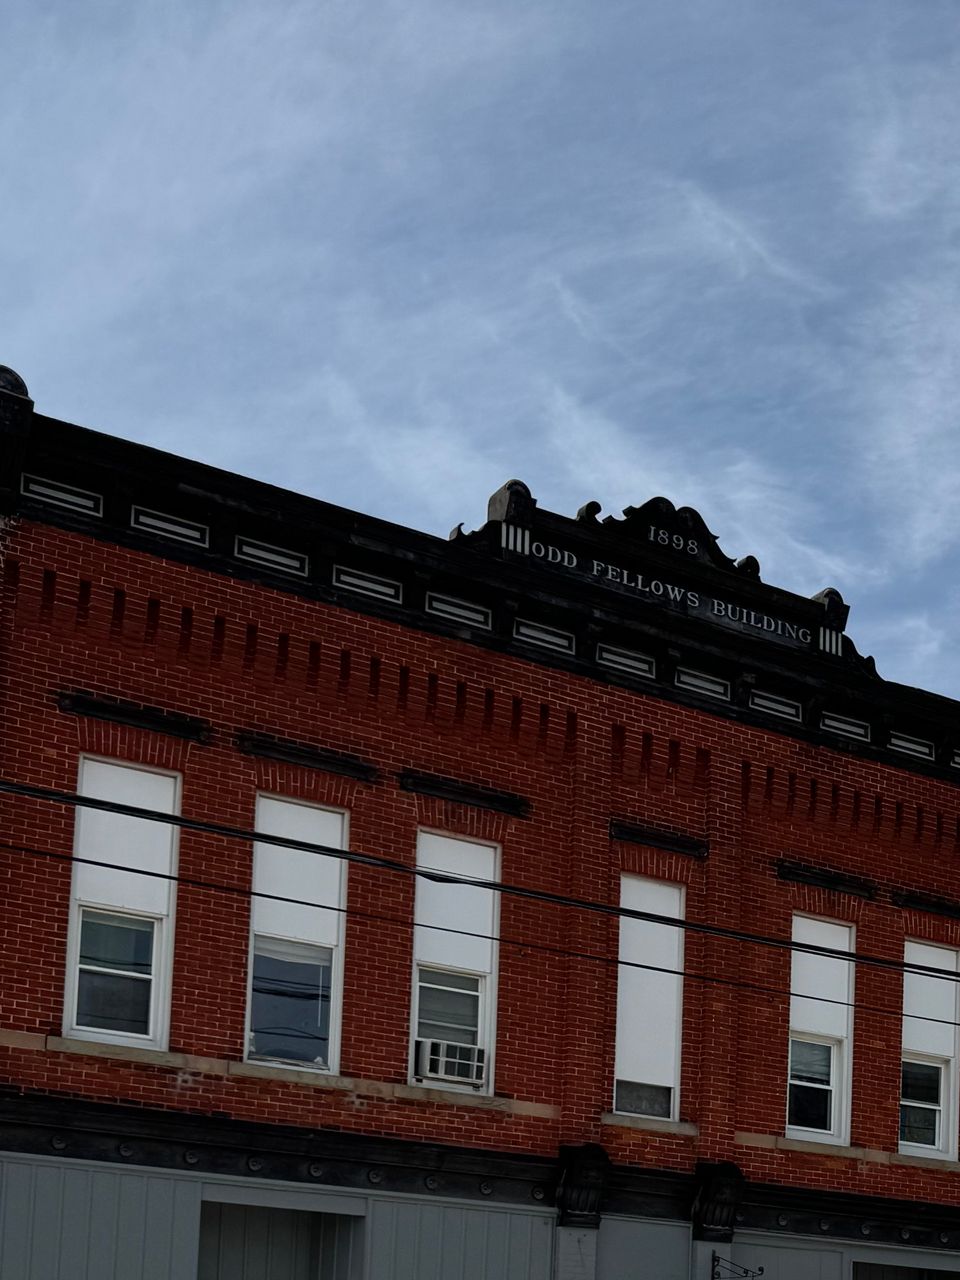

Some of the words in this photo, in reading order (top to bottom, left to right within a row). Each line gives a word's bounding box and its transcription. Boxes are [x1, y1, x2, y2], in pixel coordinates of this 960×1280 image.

[649, 525, 698, 555] 1898
[531, 541, 578, 568] ODD
[591, 559, 700, 608] FELLOWS
[712, 598, 812, 645] BUILDING
